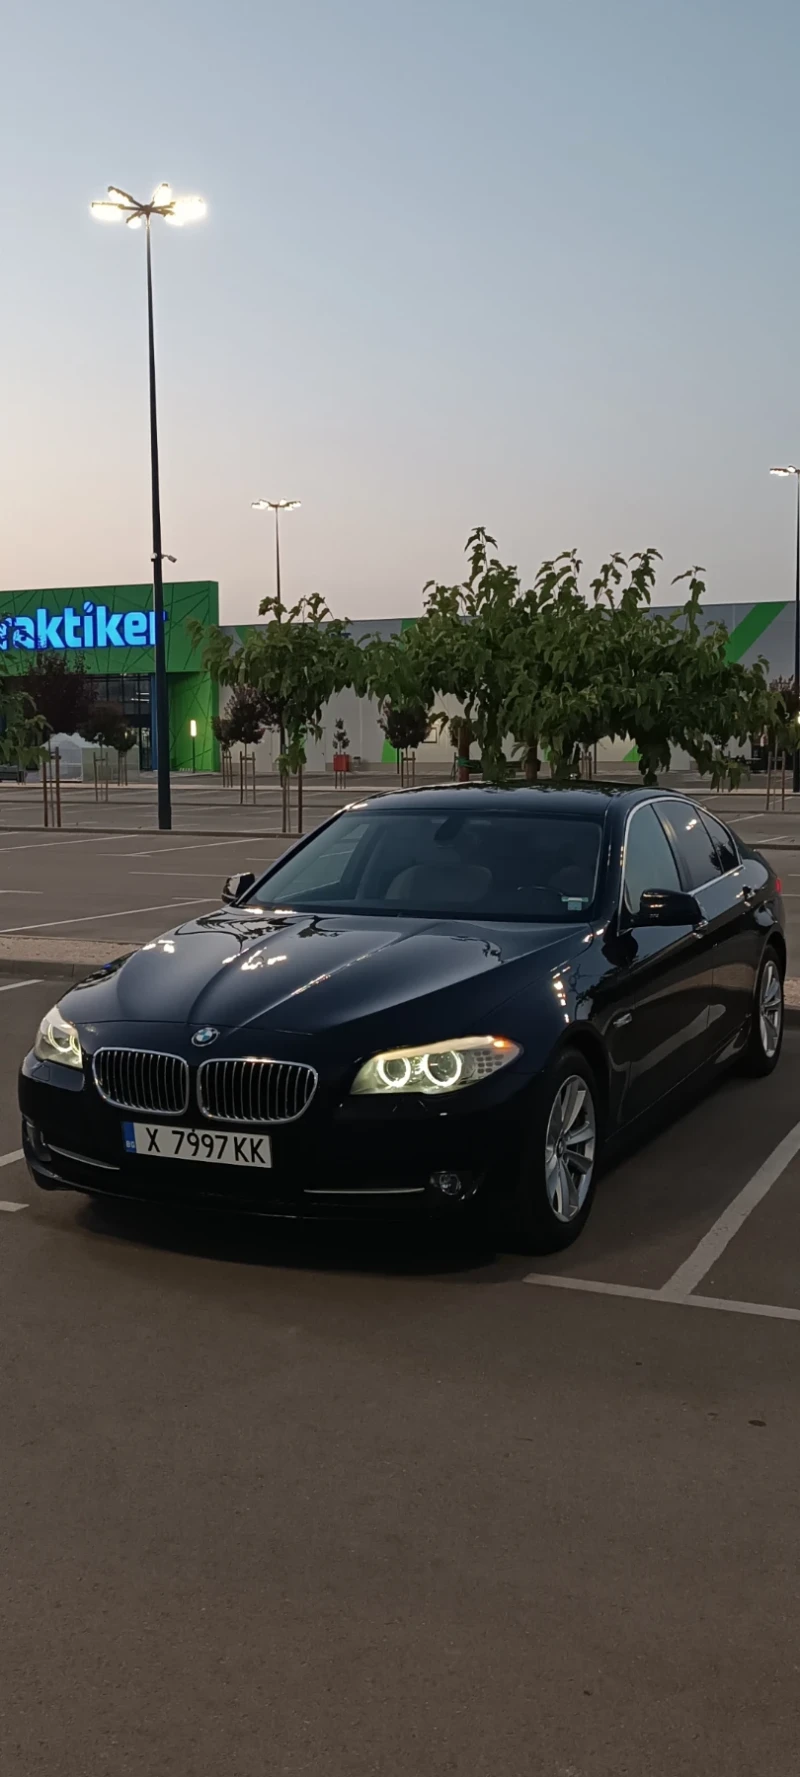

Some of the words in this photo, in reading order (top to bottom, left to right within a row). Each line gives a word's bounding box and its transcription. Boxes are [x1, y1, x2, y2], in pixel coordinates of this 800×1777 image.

[145, 1127, 160, 1153] X
[171, 1130, 228, 1160] 7997
[233, 1136, 266, 1164] KK
